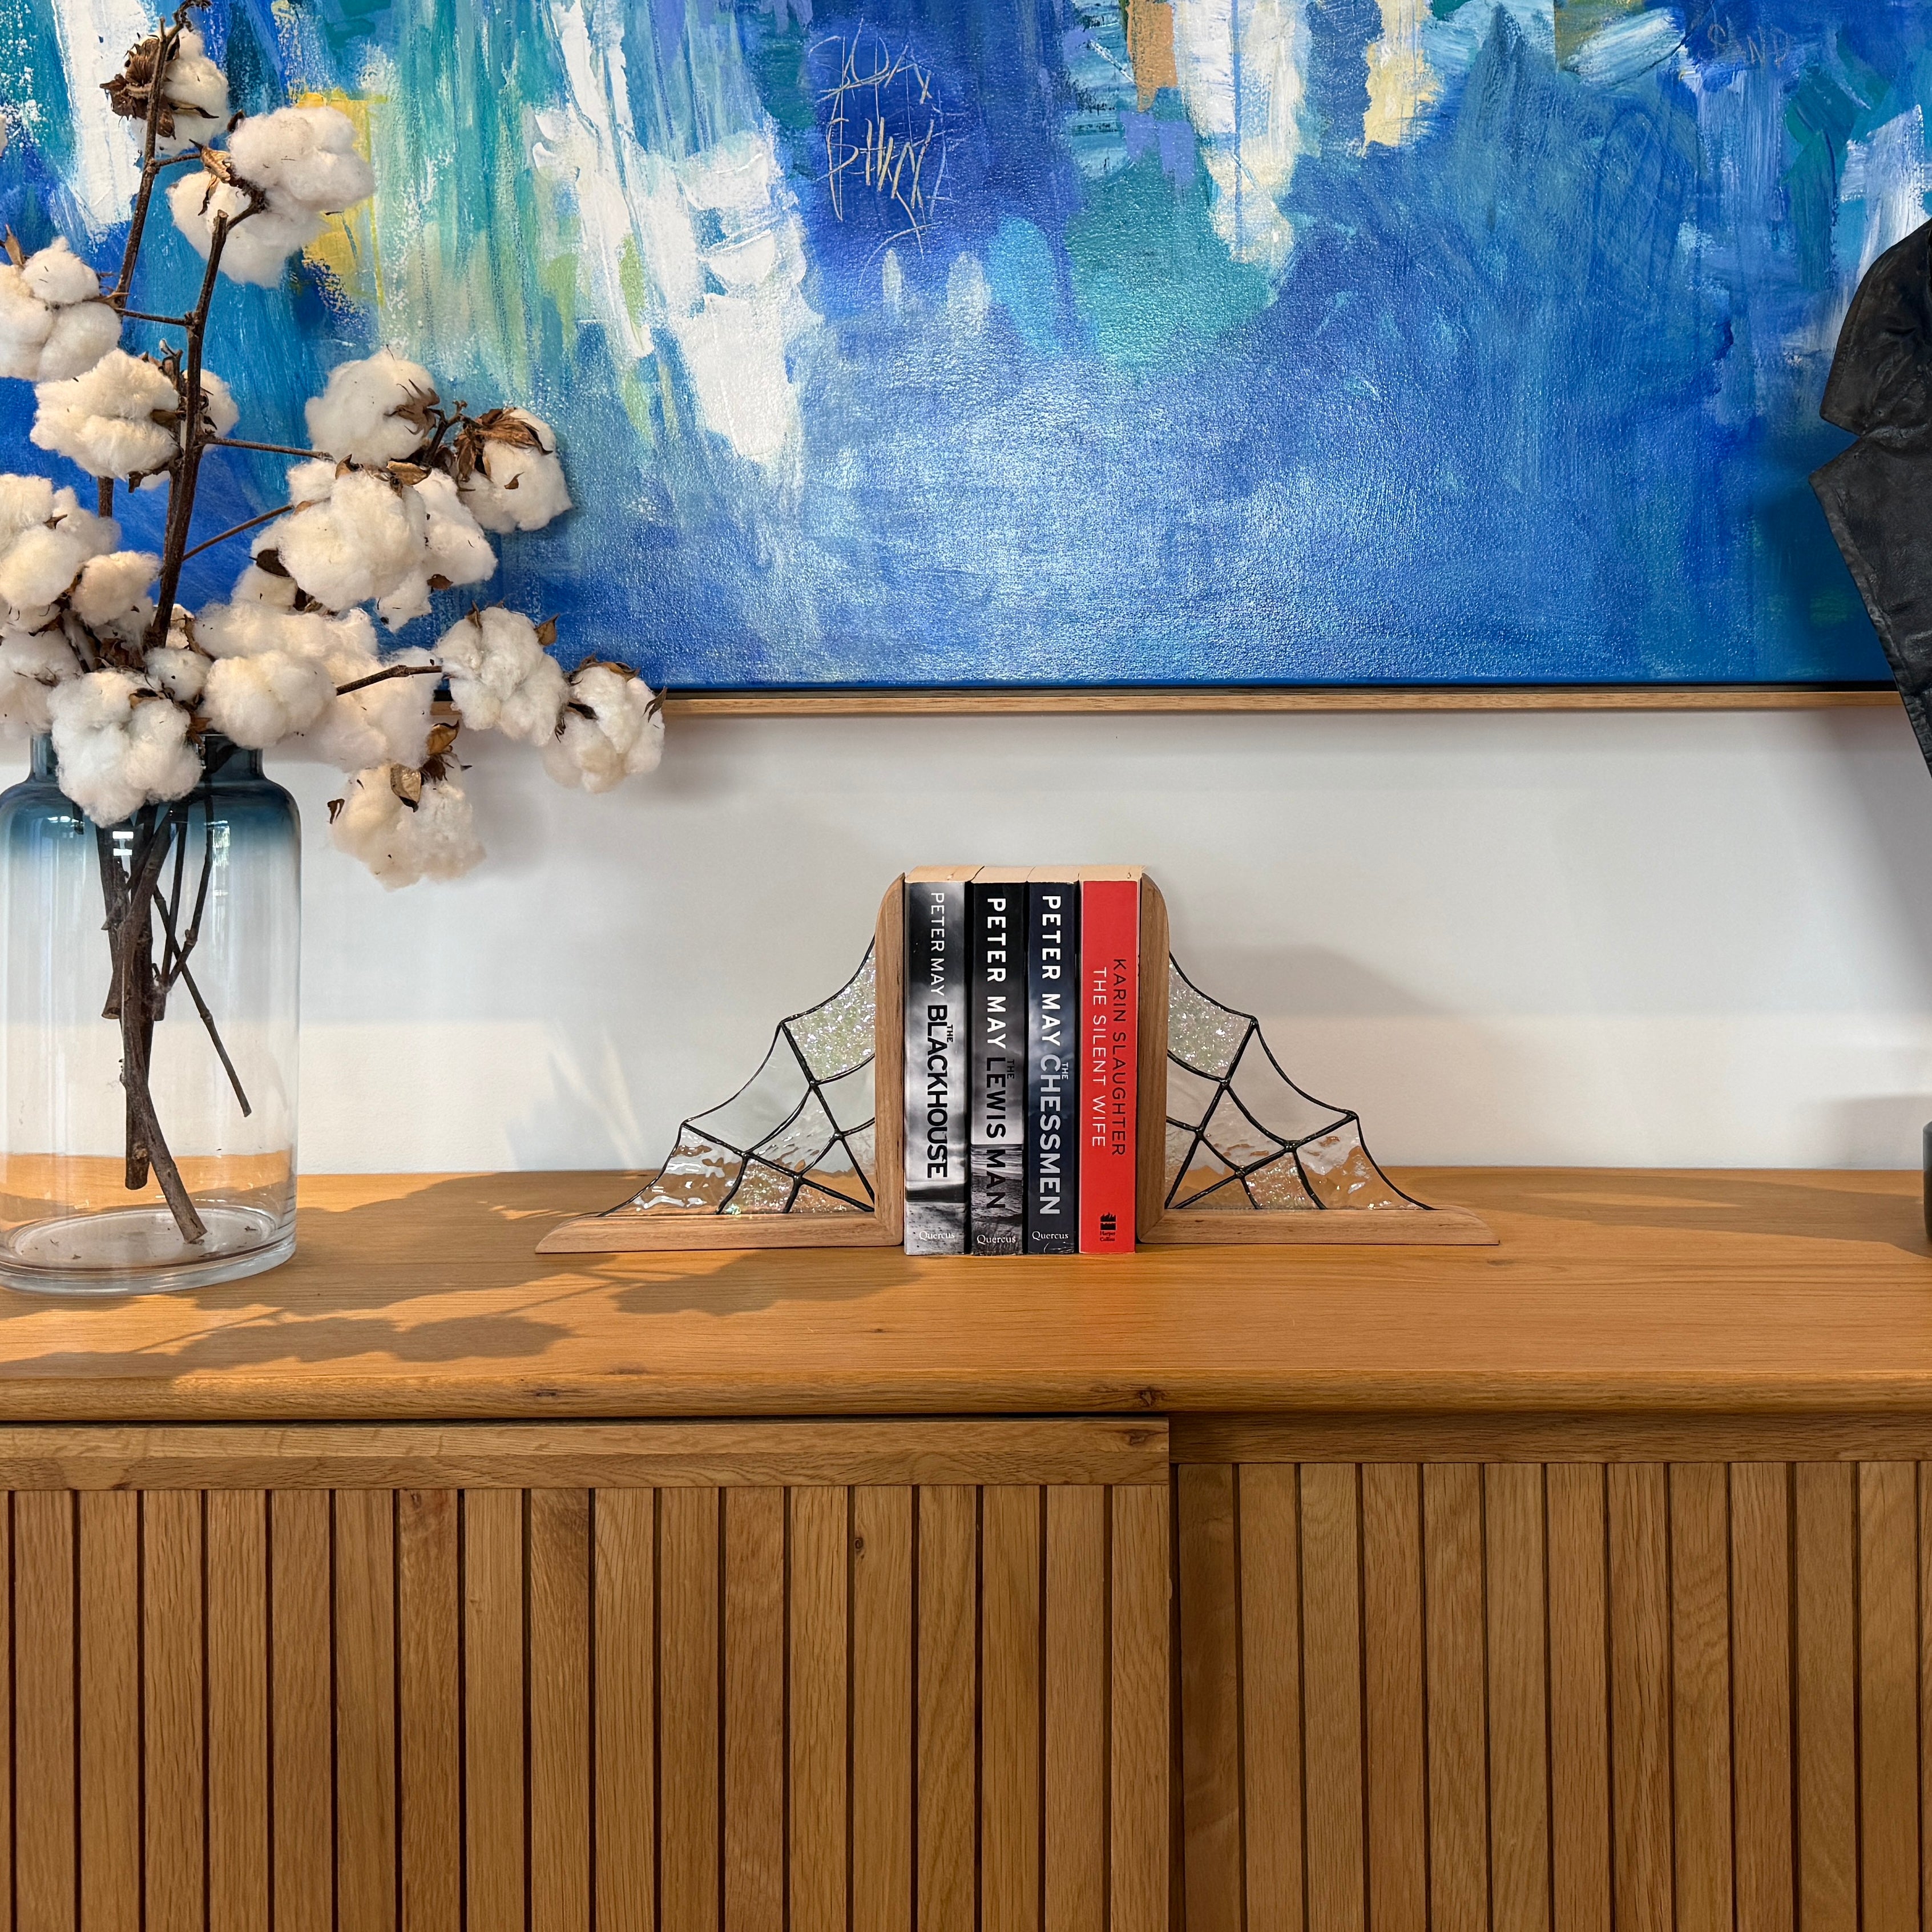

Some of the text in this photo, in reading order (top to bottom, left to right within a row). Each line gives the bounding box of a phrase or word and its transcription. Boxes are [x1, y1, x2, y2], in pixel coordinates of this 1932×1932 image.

[930, 892, 945, 997] PETER MAY
[987, 898, 1006, 1049] PETER MAY
[1042, 896, 1061, 1046] PETER MAY
[927, 1005, 947, 1178] BLACKHOUSE
[1092, 966, 1107, 1147] THE SILENT WIFE
[1112, 959, 1127, 1156] KARIN SLAUGHTER
[986, 1057, 1006, 1209] LEWIS MAN
[1039, 1054, 1061, 1214] CHESSMEN
[919, 1231, 955, 1240] Quercus
[977, 1234, 1017, 1244] Quercus
[1032, 1231, 1069, 1240] Quercus
